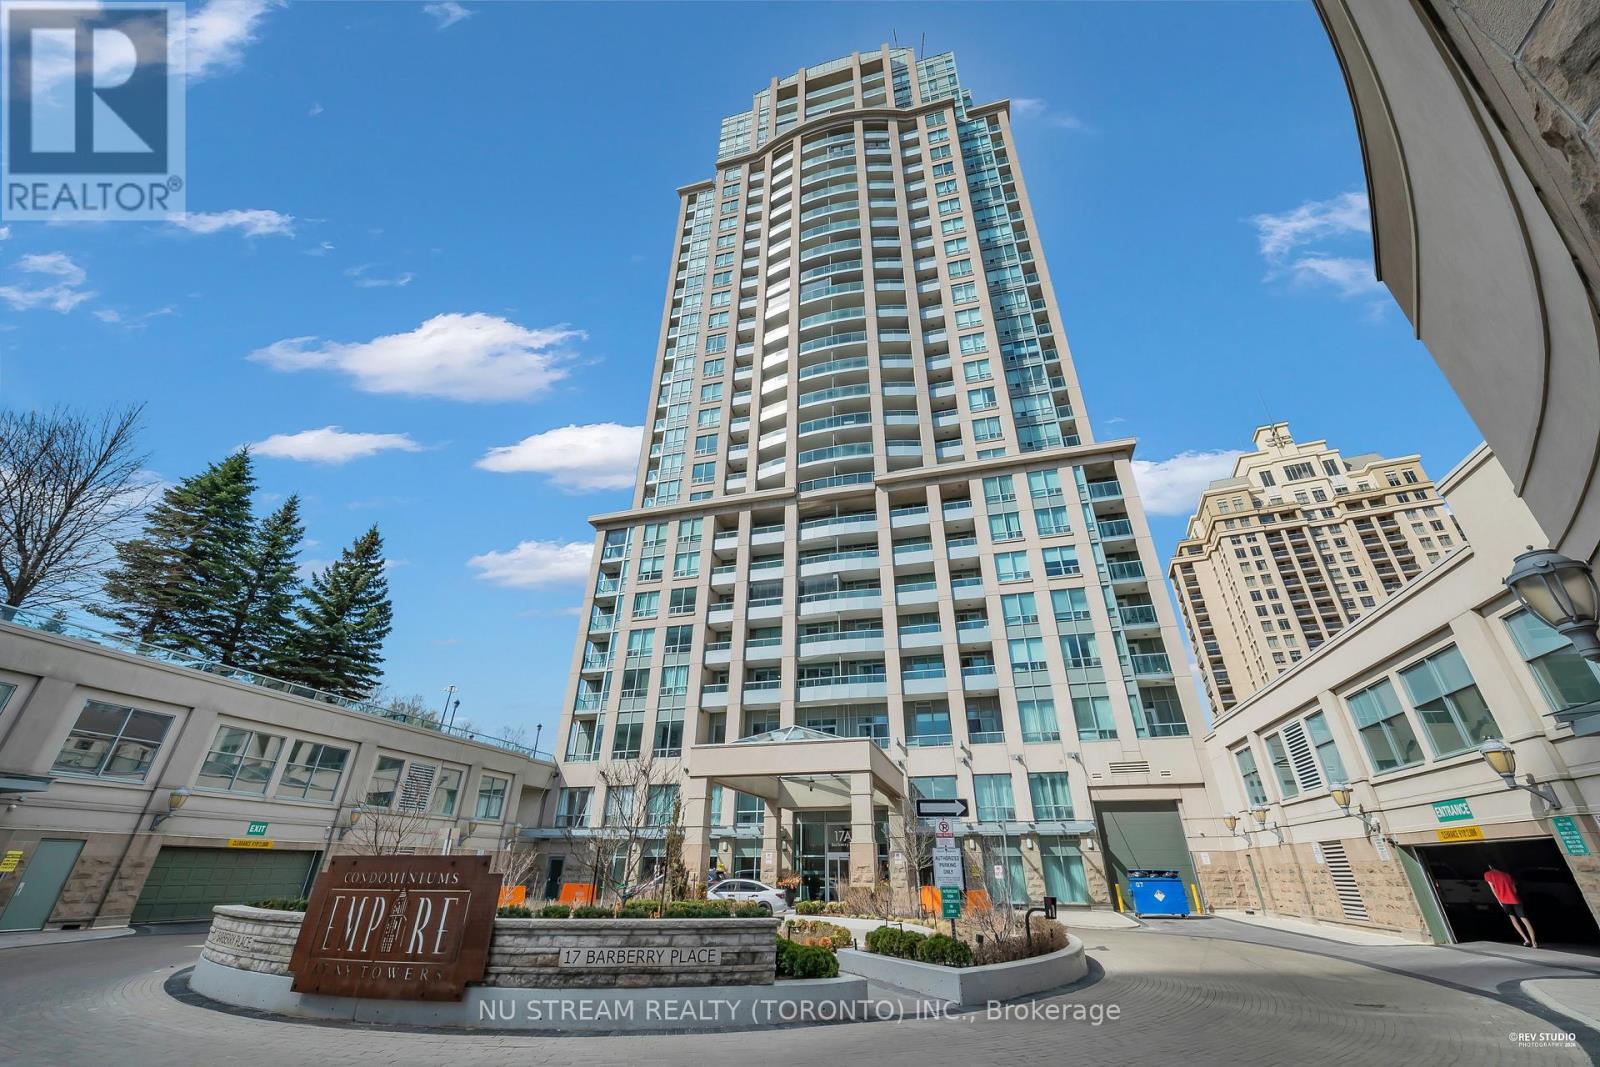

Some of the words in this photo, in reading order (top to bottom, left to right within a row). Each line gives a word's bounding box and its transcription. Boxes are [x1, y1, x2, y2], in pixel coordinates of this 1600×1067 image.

[1435, 803, 1471, 817] ENTRANCE
[249, 825, 266, 833] EXIT
[344, 871, 460, 884] CONDOMINIUMS
[563, 950, 581, 964] 17
[586, 950, 665, 964] BARBERRY
[670, 949, 716, 964] PLACE
